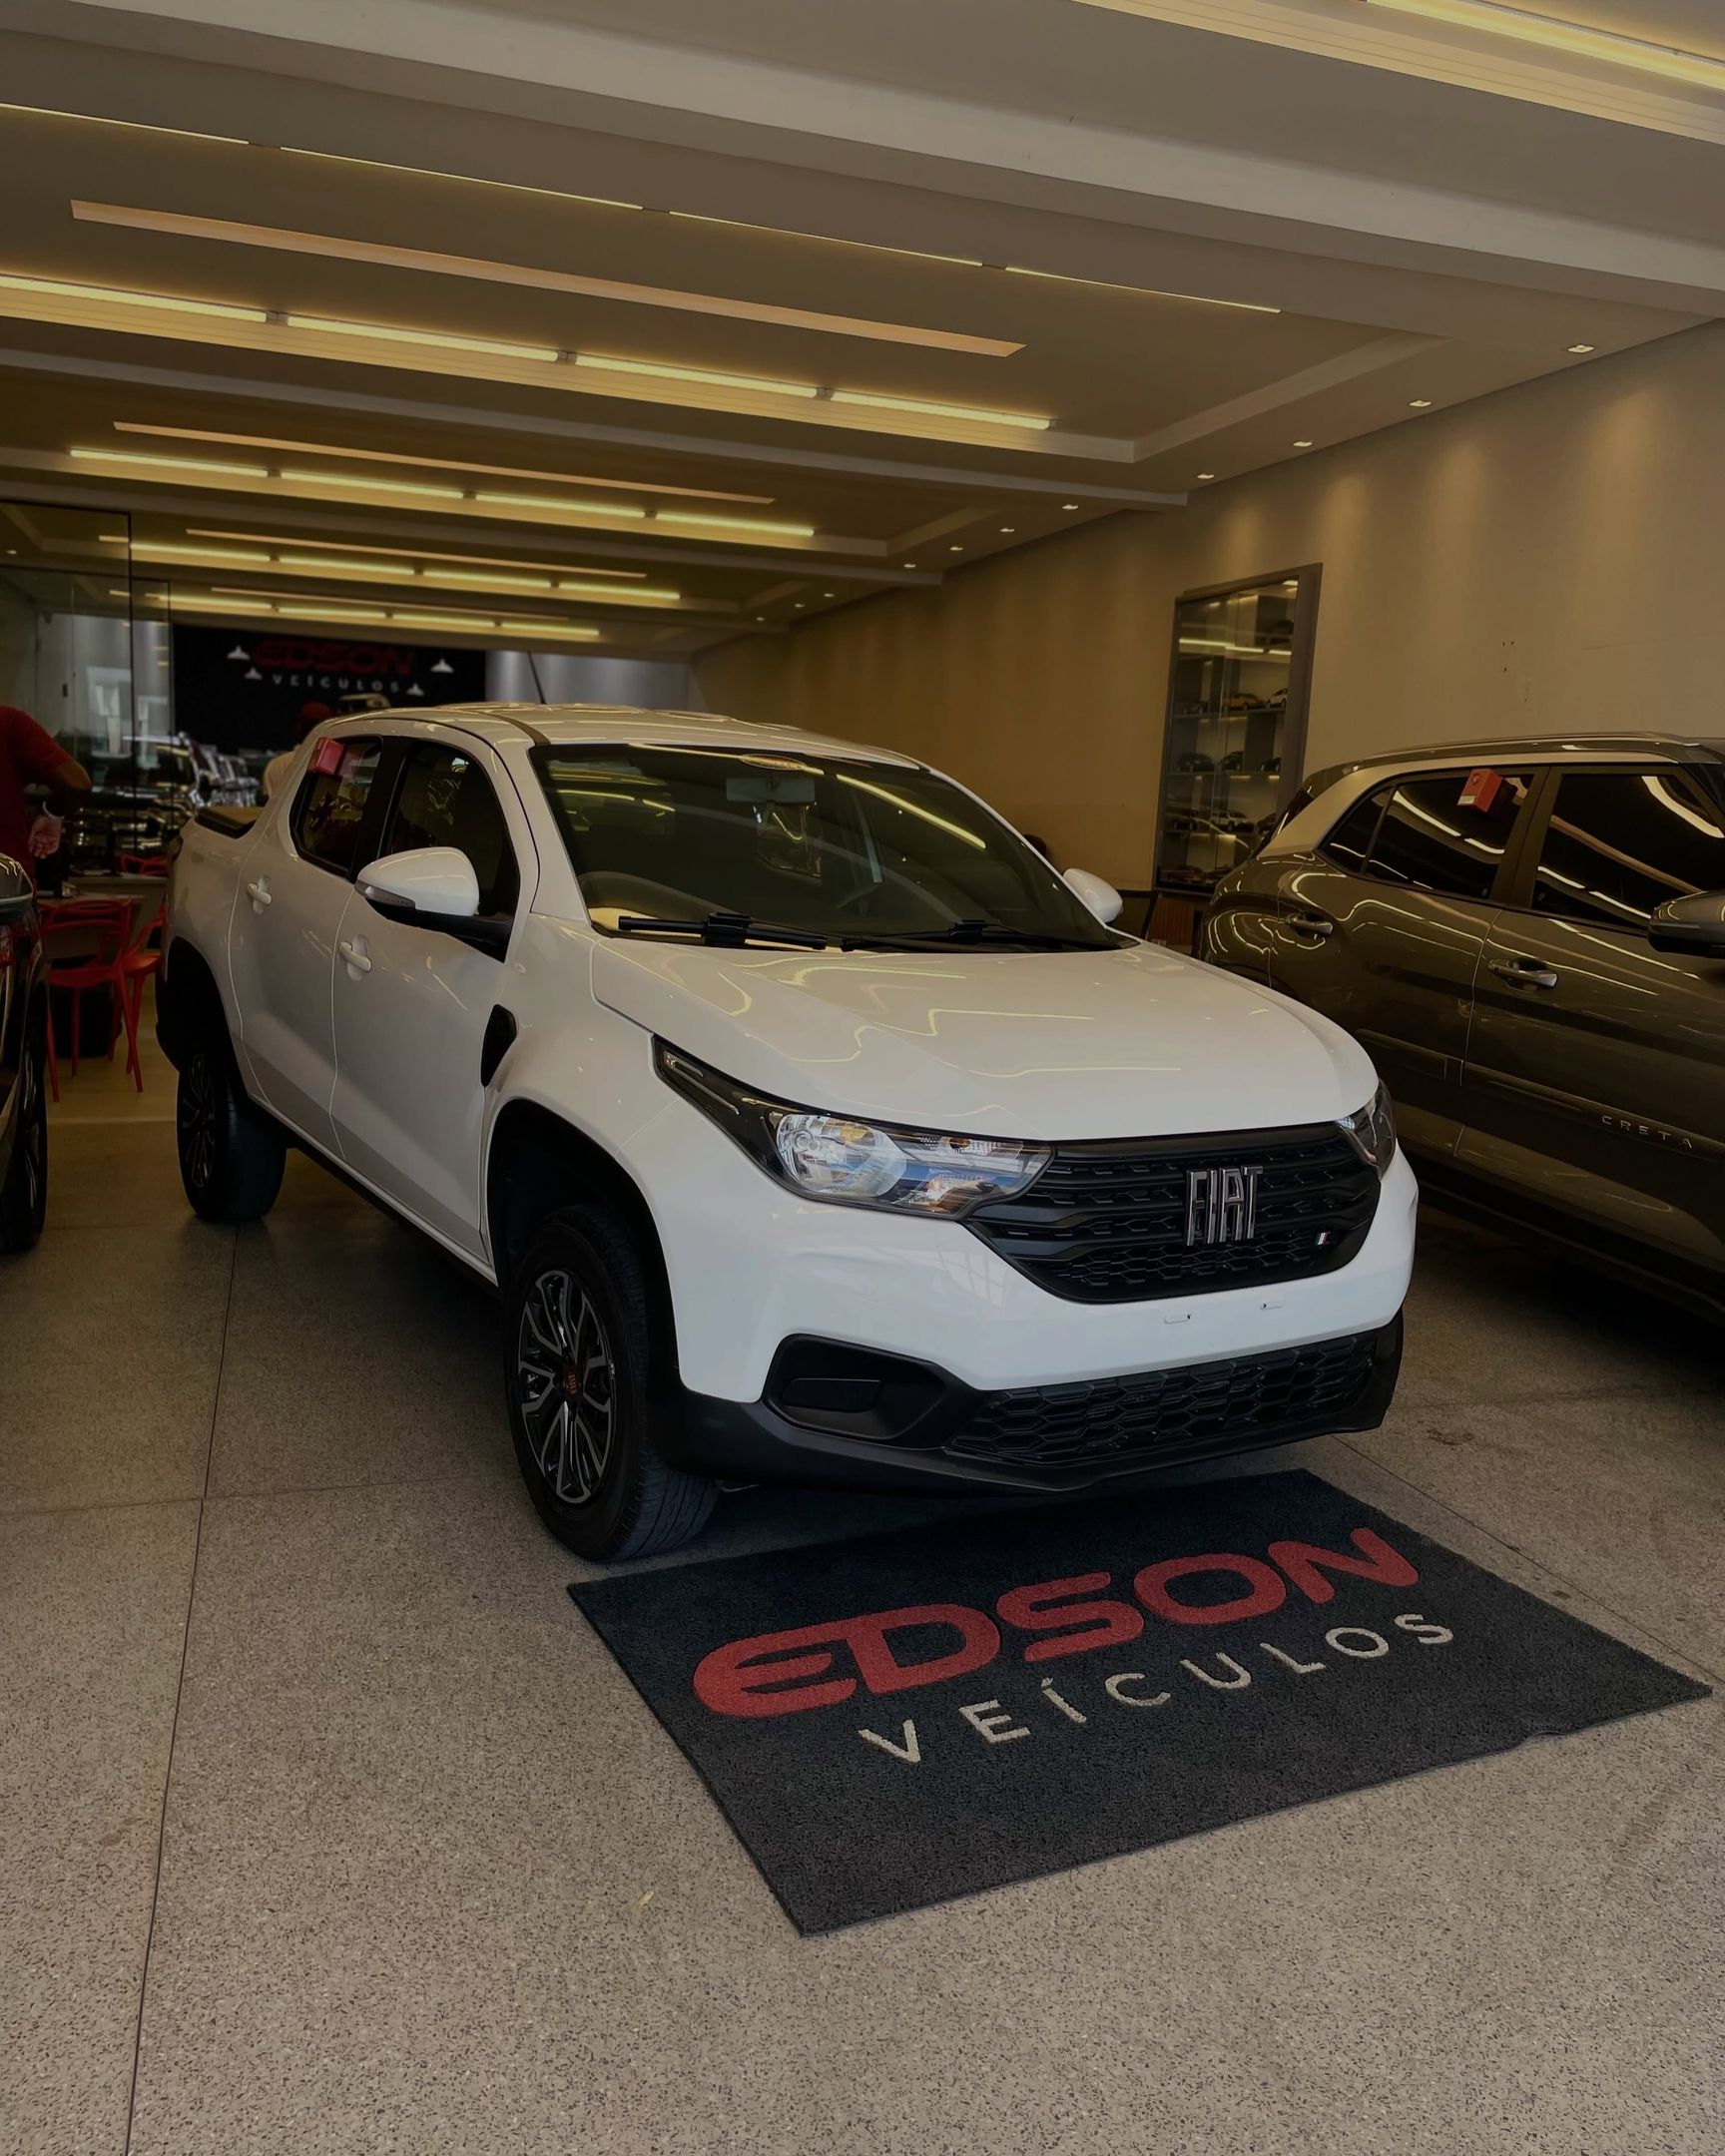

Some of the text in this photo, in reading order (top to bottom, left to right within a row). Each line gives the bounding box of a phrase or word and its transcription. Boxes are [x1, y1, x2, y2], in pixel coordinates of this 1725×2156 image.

[255, 638, 414, 677] EDSON
[1601, 1115, 1693, 1149] CRETA
[1184, 1165, 1264, 1247] FIAT
[694, 1529, 1418, 1717] EDSON
[859, 1613, 1453, 1764] VEÍCULOS
